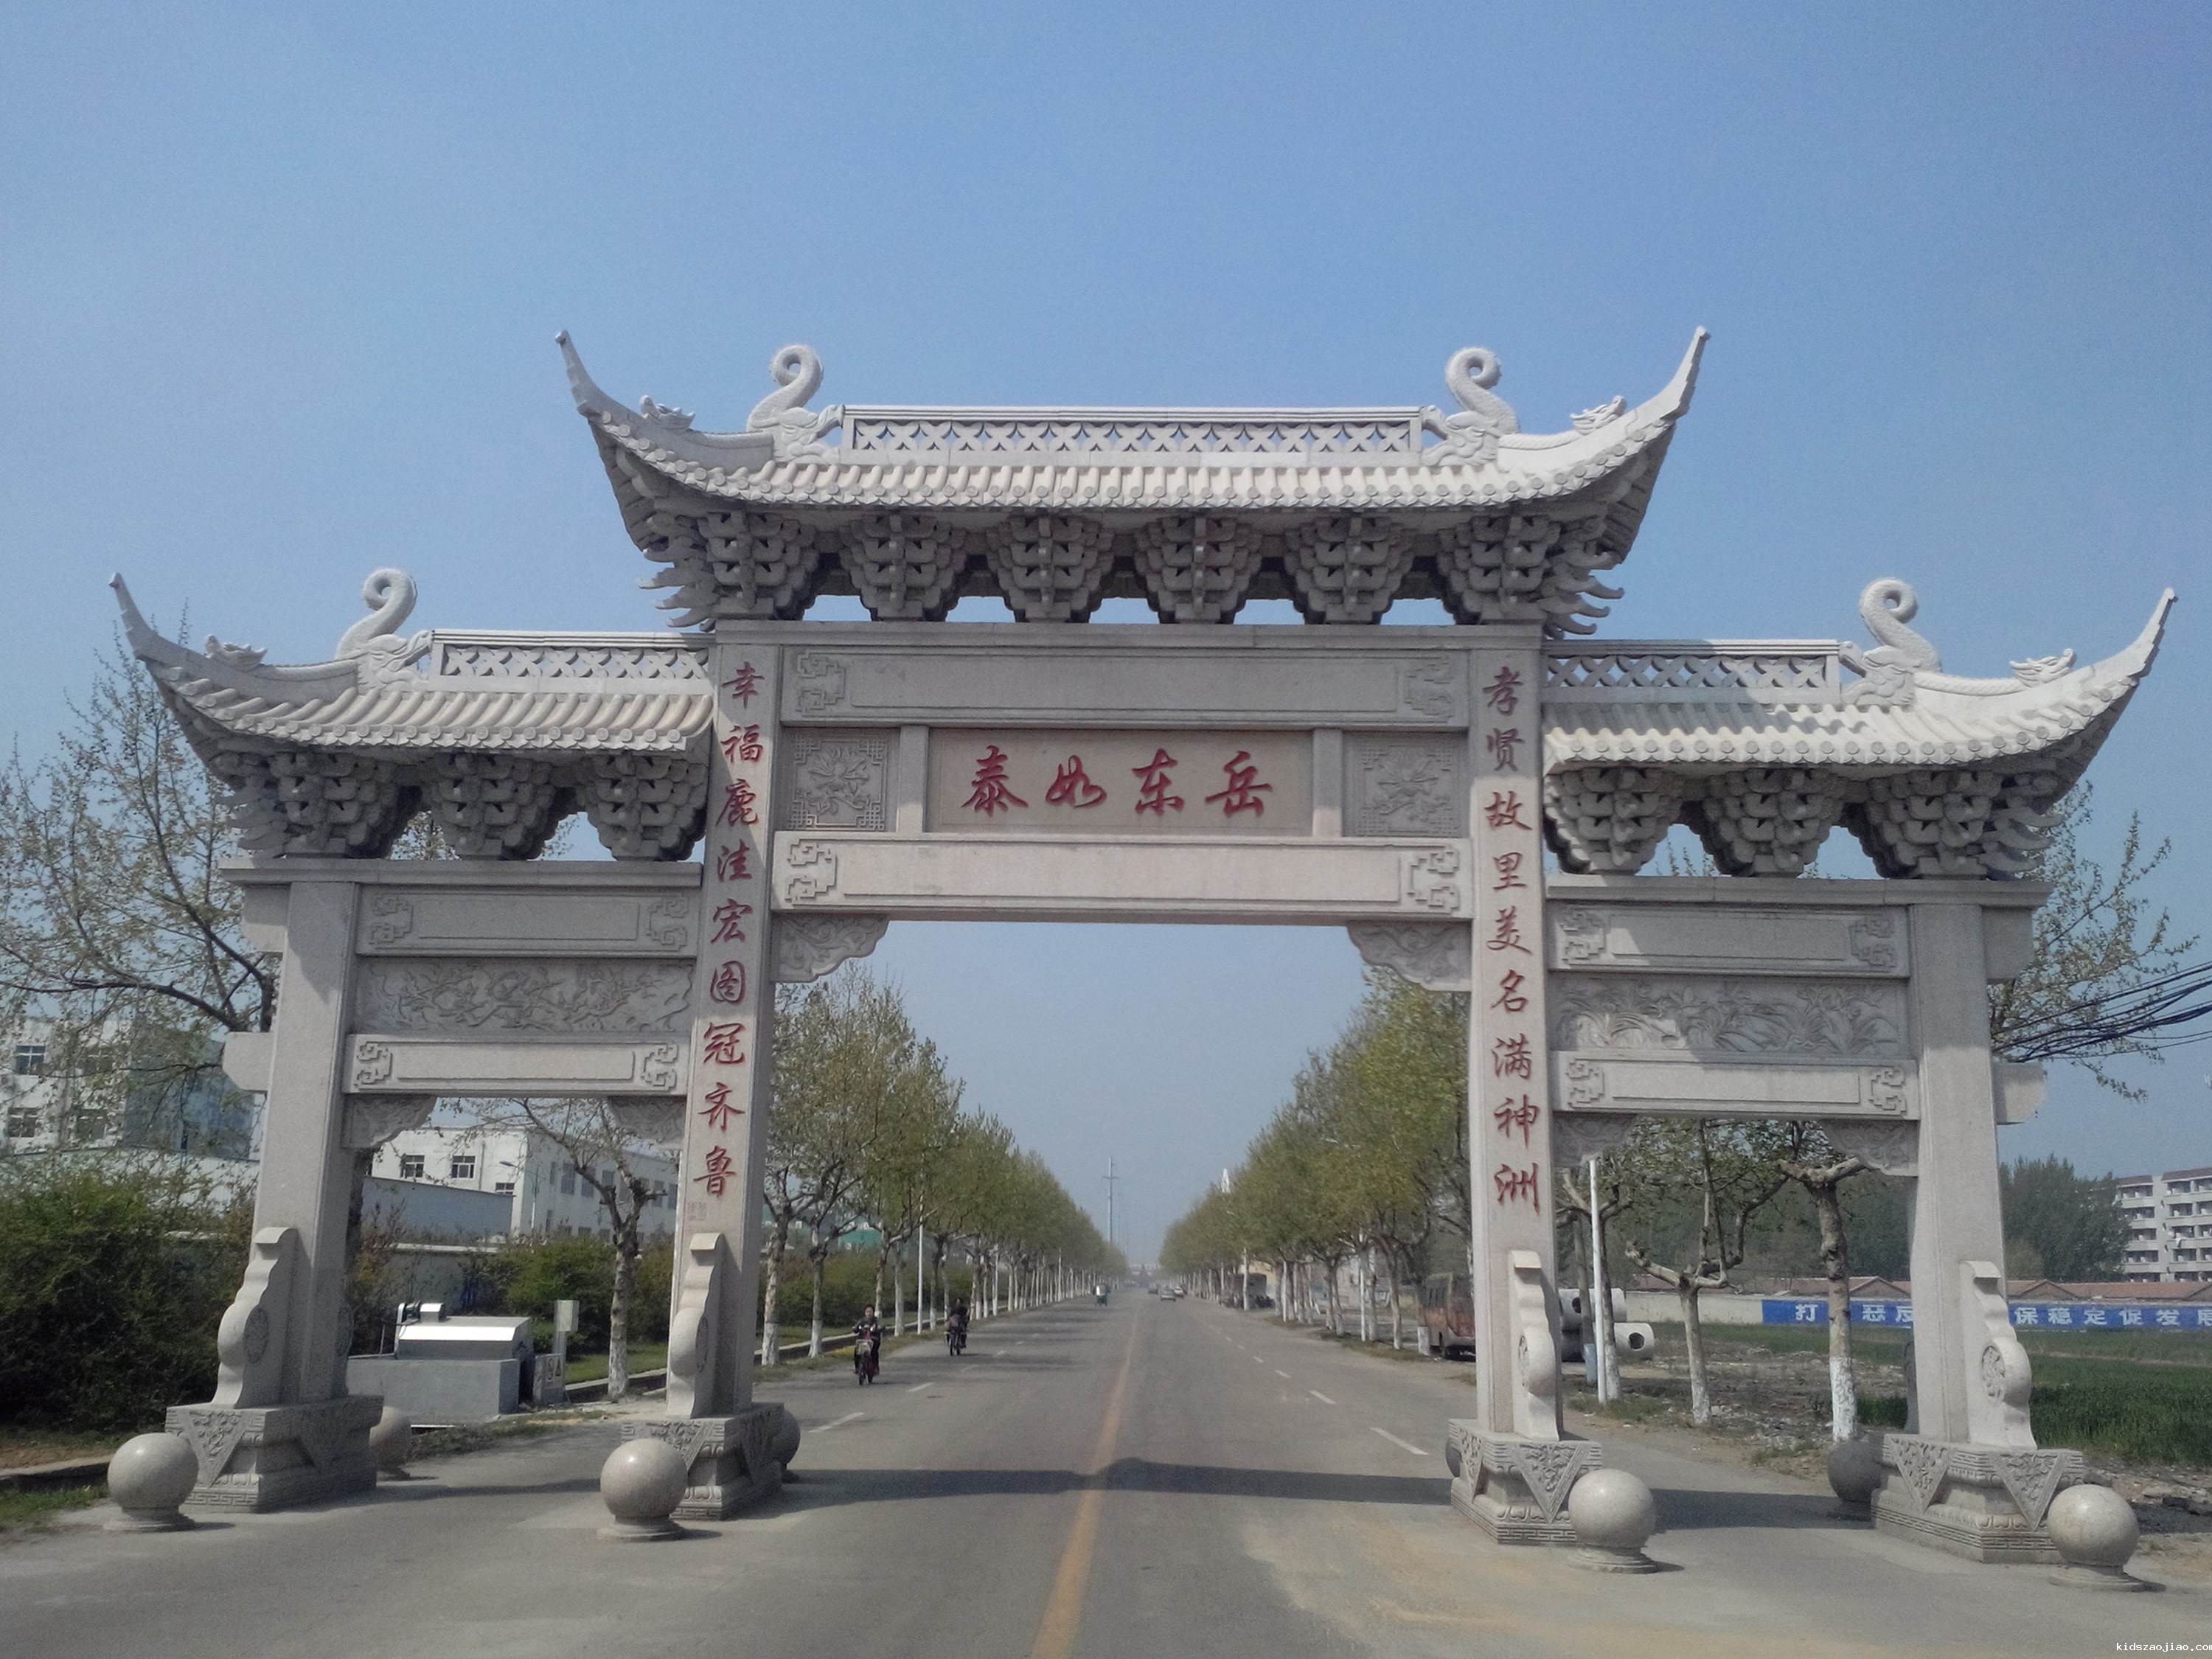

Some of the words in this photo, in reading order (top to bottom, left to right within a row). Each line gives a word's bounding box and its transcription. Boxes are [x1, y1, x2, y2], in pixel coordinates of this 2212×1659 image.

[692, 661, 765, 1197] 幸福鹿洼宏图冠齐鲁
[961, 745, 1273, 818] 泰如东岳
